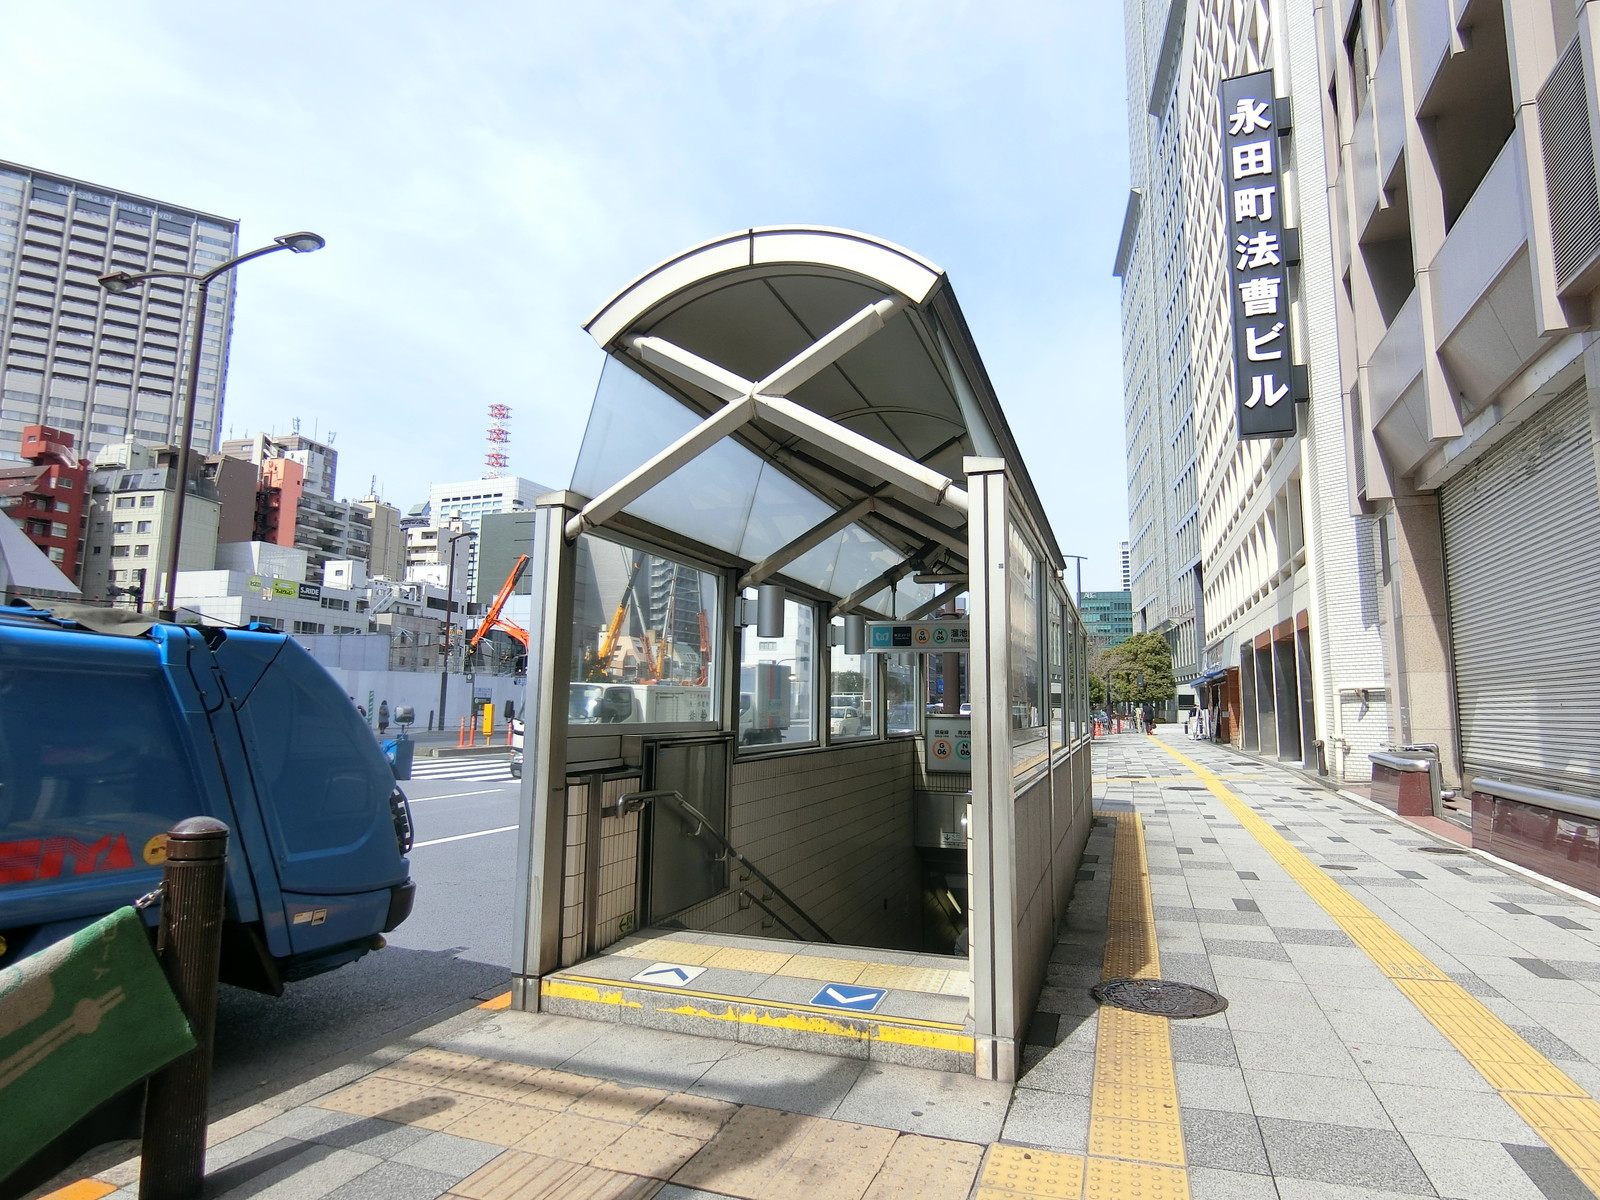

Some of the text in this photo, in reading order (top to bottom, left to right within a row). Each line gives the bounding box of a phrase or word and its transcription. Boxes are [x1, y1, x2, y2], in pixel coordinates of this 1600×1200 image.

[57, 185, 101, 203] Aksaka
[1228, 97, 1289, 409] 永田町法曹ビル
